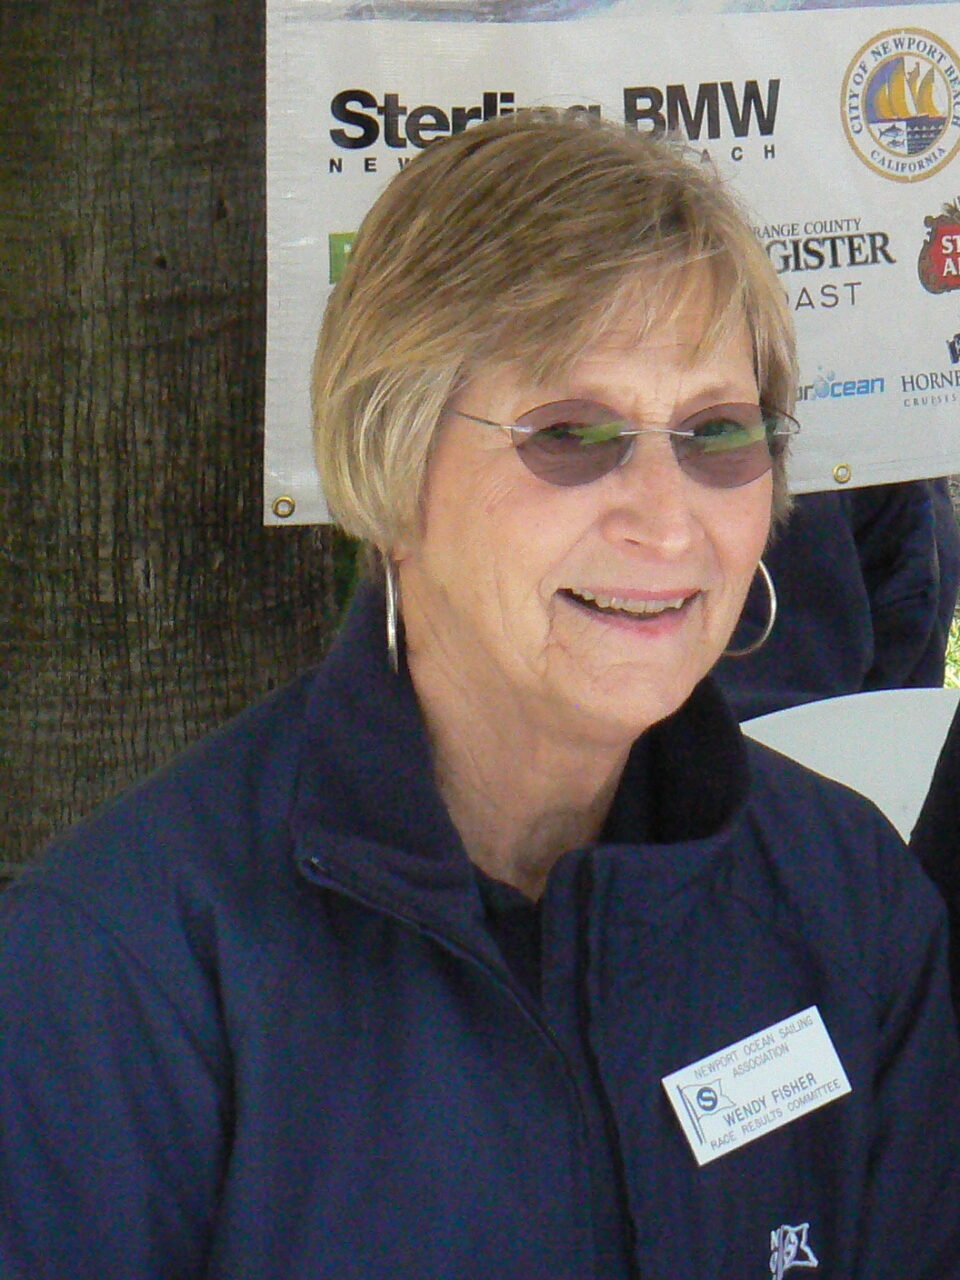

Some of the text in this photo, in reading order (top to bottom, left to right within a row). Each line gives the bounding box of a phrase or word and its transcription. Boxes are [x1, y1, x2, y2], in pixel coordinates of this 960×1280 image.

[870, 36, 947, 65] NEWPORT
[853, 60, 869, 87] OF
[330, 78, 781, 149] Sterl BMW
[849, 89, 864, 135] CITY
[870, 146, 946, 173] CALIFORNIA
[753, 218, 862, 239] RANGE COUNTY
[766, 231, 897, 274] GISTER
[785, 281, 862, 311] AST
[903, 393, 957, 408] CRUISES
[693, 1015, 814, 1080] NEWPORT OCEAN SAILING
[732, 1042, 790, 1079] ASSOCIATION
[710, 1078, 841, 1151] RACE RESULTS COMMITTEE
[722, 1072, 817, 1127] WENDY FISHER
